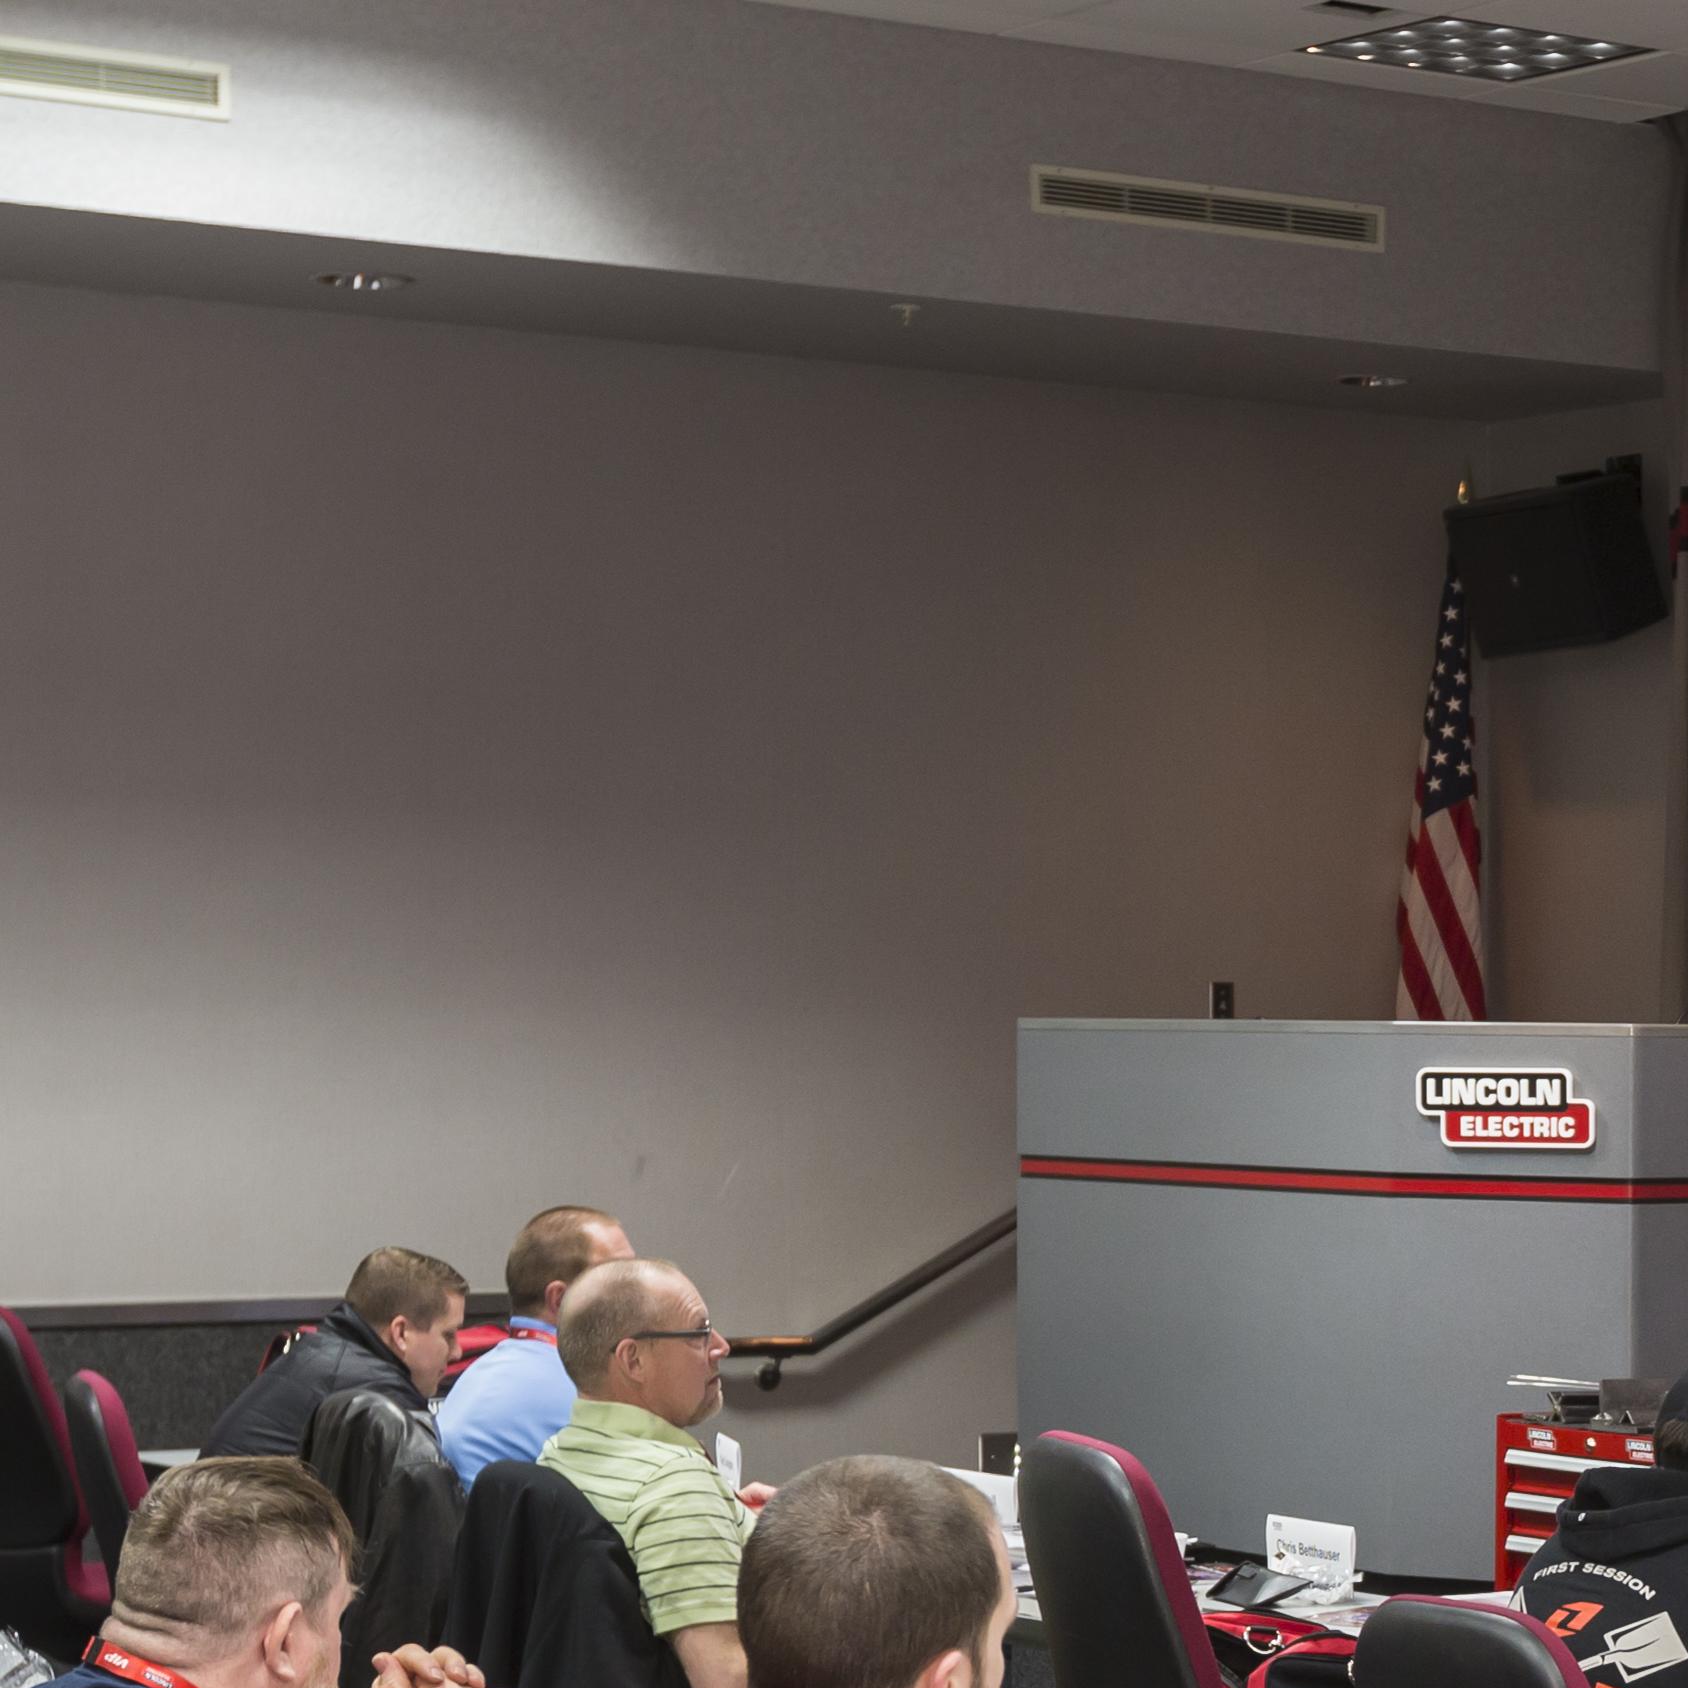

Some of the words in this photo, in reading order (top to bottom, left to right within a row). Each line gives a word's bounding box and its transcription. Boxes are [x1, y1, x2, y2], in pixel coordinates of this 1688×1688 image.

[1426, 1077, 1561, 1106] LINCOLN
[1460, 1115, 1576, 1138] ELECTRIC
[1533, 1561, 1580, 1581] FIRST
[1582, 1563, 1656, 1600] SESSION
[104, 1652, 129, 1669] VIP
